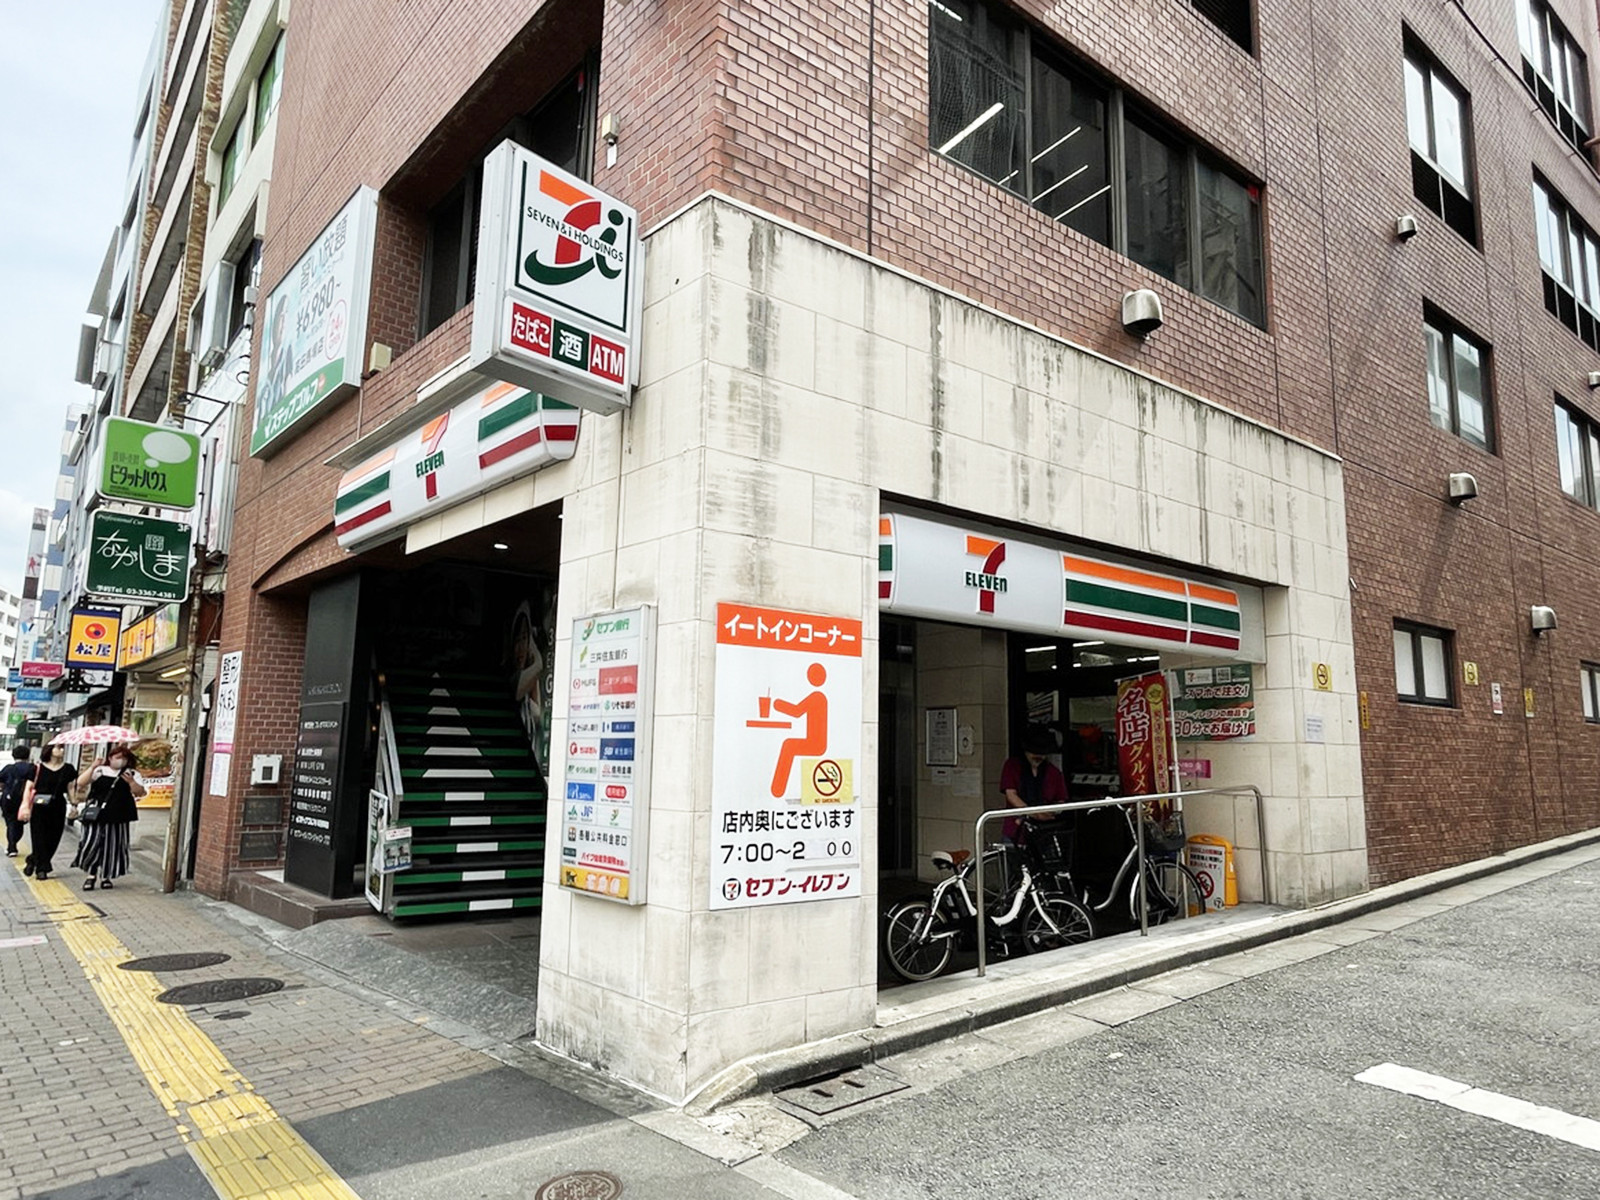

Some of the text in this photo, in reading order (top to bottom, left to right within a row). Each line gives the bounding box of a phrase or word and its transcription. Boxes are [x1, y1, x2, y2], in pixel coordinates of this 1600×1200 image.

[574, 230, 624, 262] HOLDINGS
[512, 312, 624, 378] たばこ 酒 ATM
[110, 464, 167, 492] ピタットハウス
[177, 523, 190, 532] 3F
[724, 613, 856, 647] イートインコーナー
[75, 641, 111, 656] 松屋
[590, 648, 628, 663] 三井住友銀行
[1129, 743, 1148, 796] グルメ
[722, 809, 855, 833] 店内奥にございます
